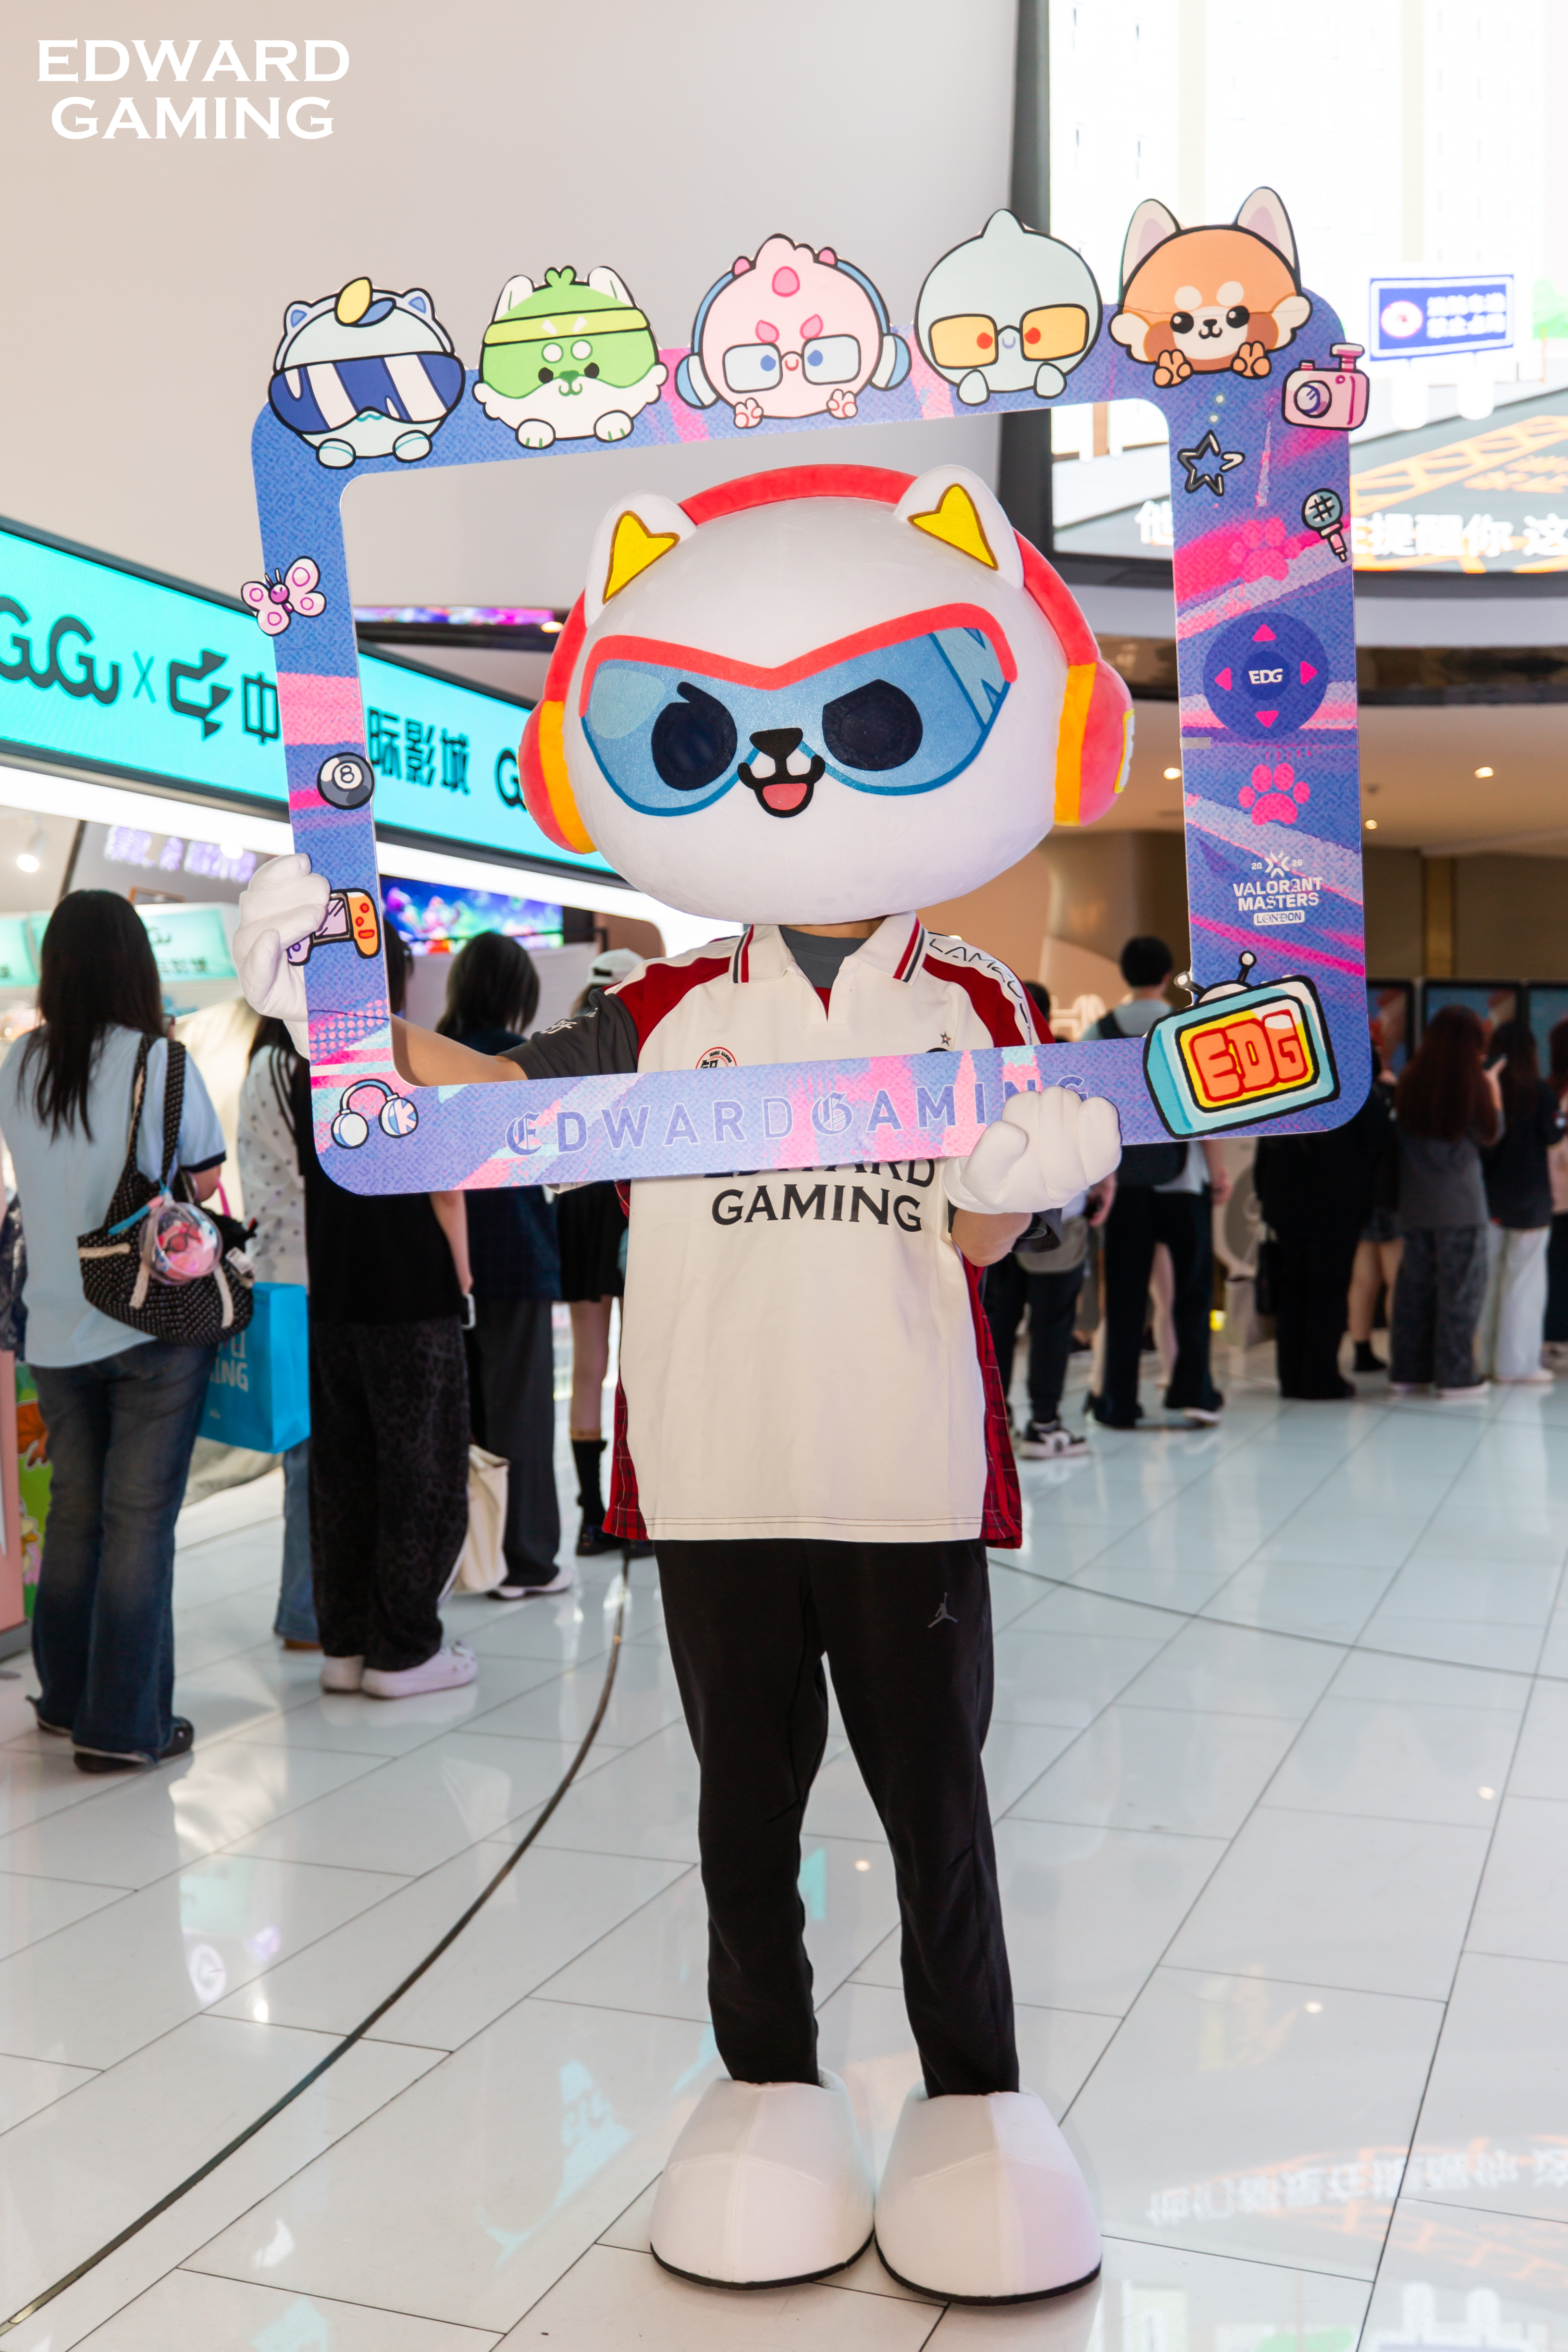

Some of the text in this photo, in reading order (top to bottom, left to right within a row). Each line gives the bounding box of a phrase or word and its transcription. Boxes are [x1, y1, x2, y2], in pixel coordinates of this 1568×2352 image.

[1248, 668, 1283, 684] EDG
[340, 765, 355, 784] 8
[1233, 877, 1322, 896] VALORANT
[1238, 892, 1319, 911] MASTERS
[1257, 912, 1301, 923] LONDON
[1188, 1009, 1309, 1102] EDG
[712, 1184, 922, 1232] GAMING
